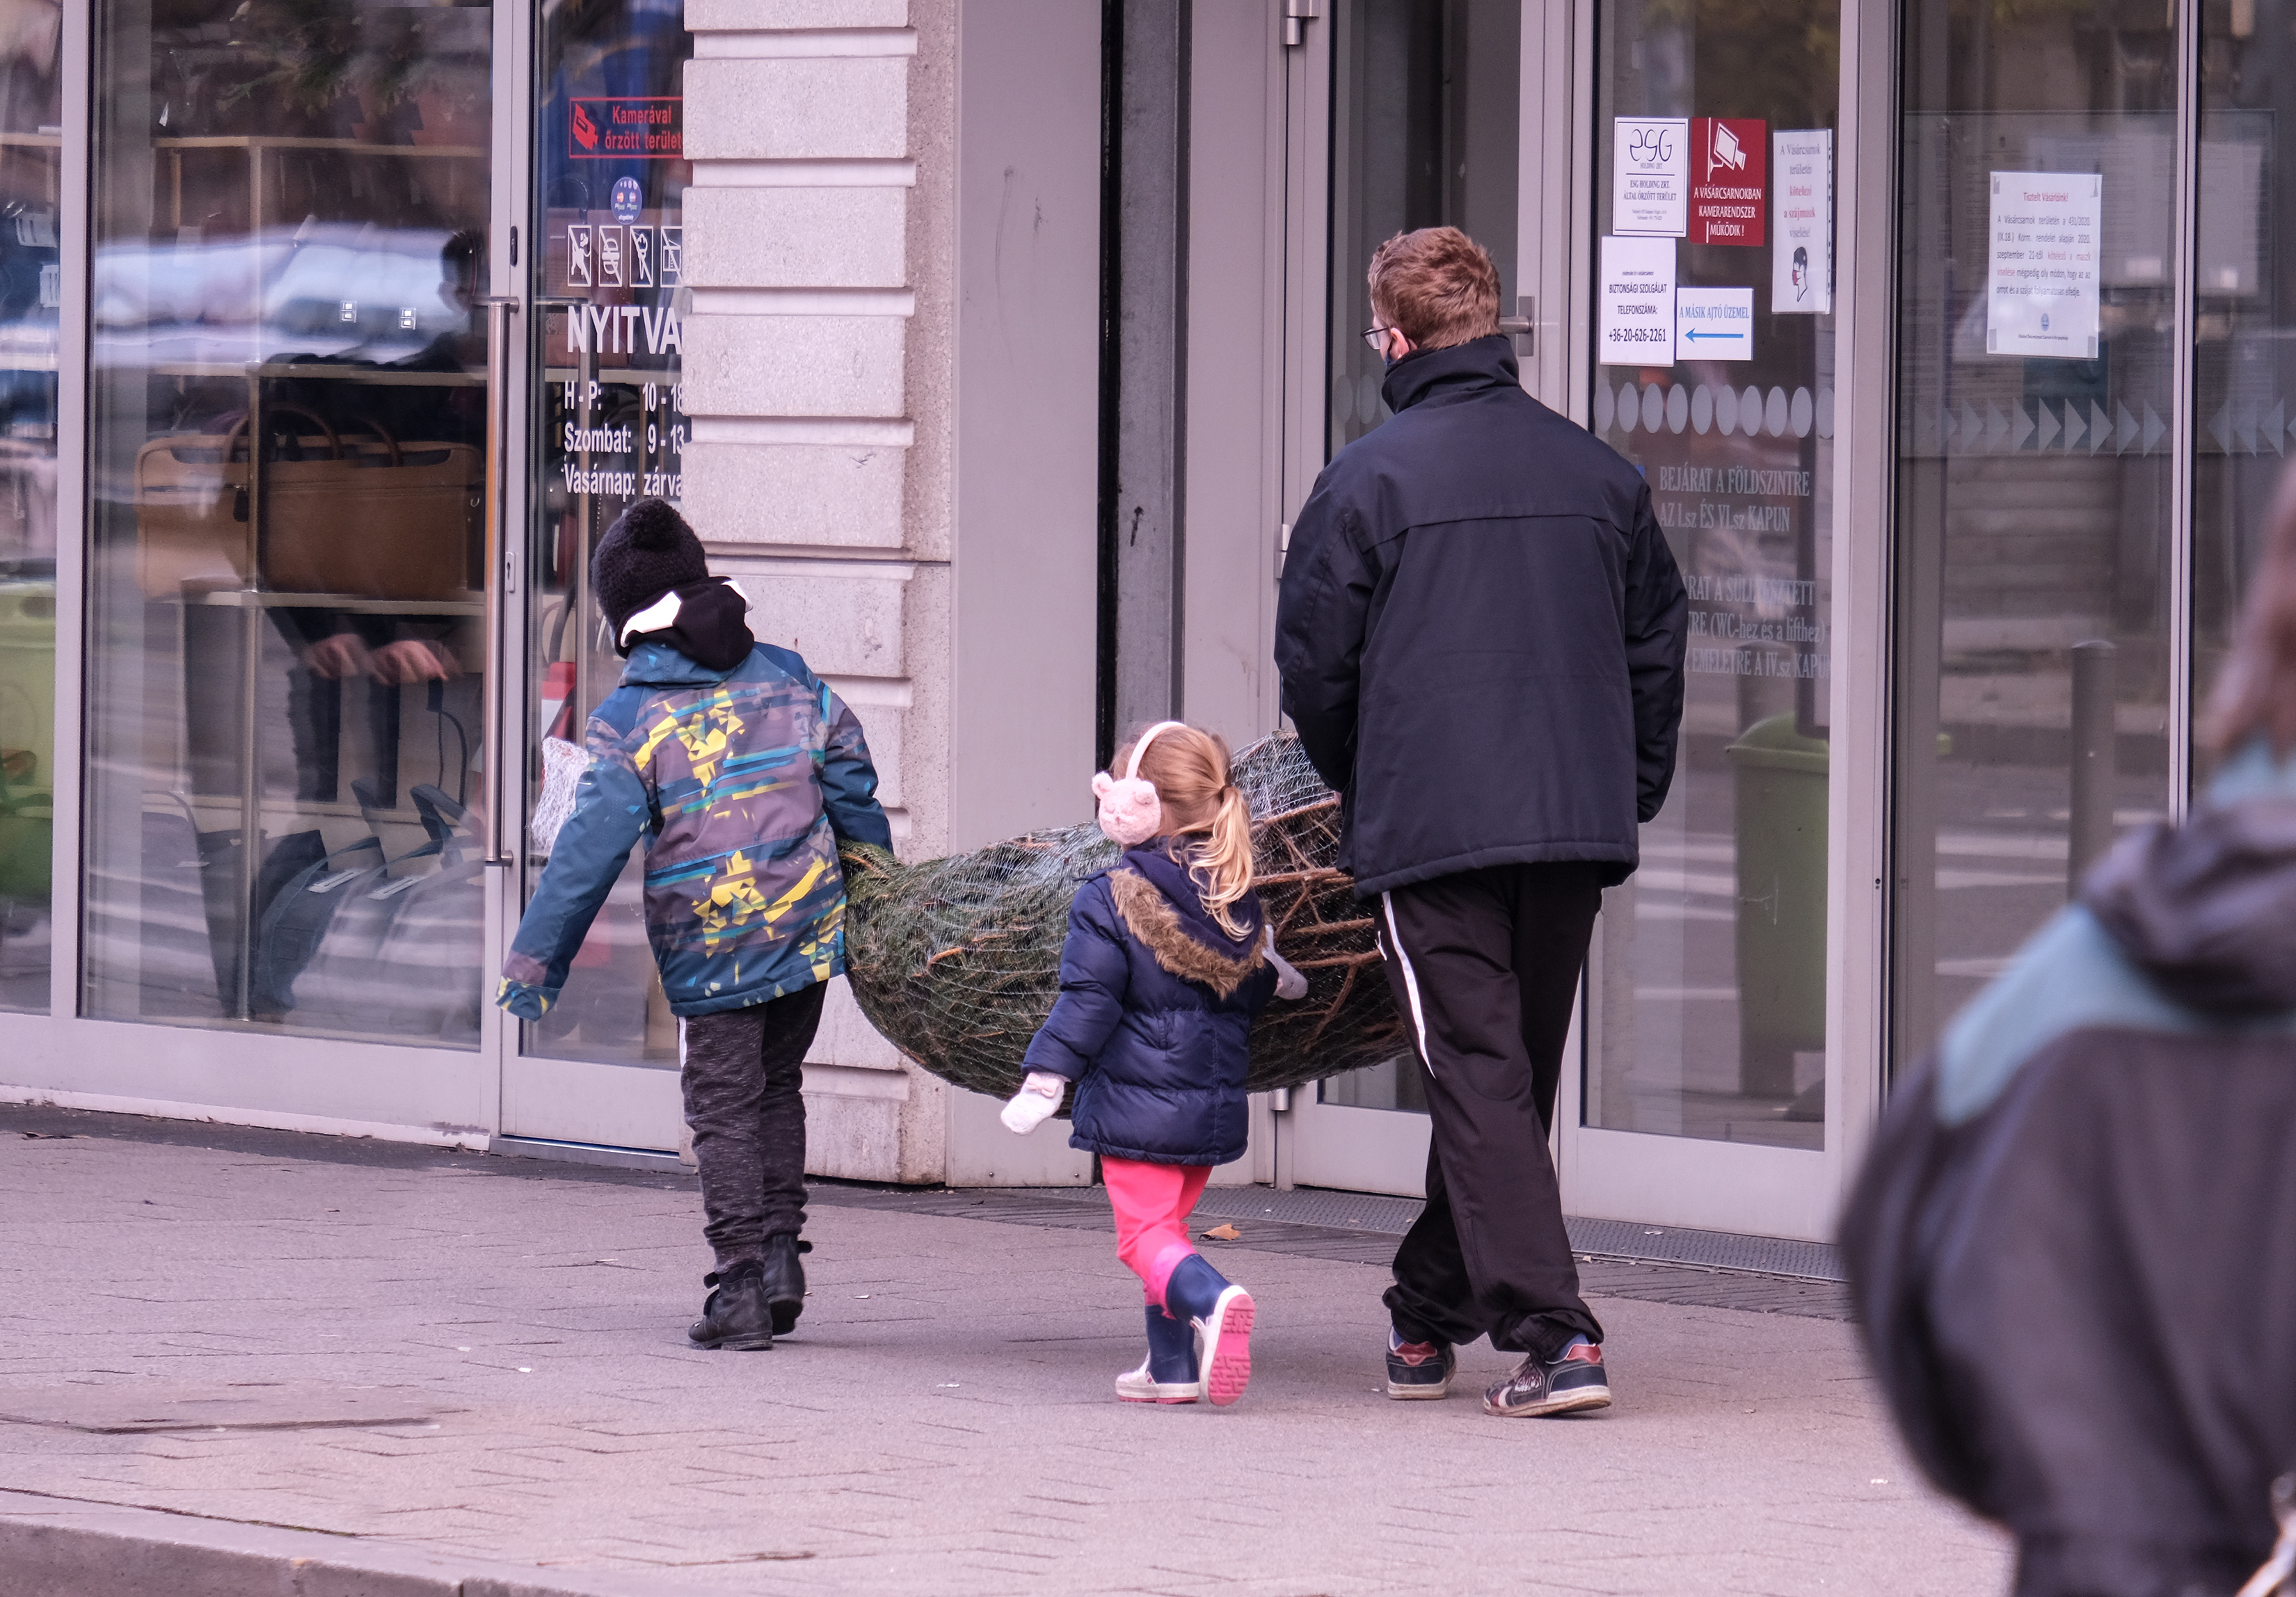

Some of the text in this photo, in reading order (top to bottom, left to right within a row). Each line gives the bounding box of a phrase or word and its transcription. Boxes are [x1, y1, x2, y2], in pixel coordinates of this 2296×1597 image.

[612, 106, 671, 124] Kamerával
[605, 130, 682, 149] őrzött terület
[1780, 145, 1785, 155] A
[1623, 190, 1637, 200] ÁLTAL
[1693, 184, 1762, 200] A VÁSÁRCSARNOKBAN
[2023, 193, 2041, 201] Tisztelt
[1698, 206, 1755, 218] KAMERARENDSZER
[1784, 210, 1787, 218] a
[2018, 234, 2032, 242] Korm.
[2078, 235, 2091, 243] 2020.
[1997, 250, 2024, 260] szeptember
[2076, 252, 2091, 261] maszk
[2067, 270, 2077, 280] hogy
[1609, 282, 1667, 294] BIZTONSÁGI SZOLGÁLAT
[1618, 303, 1657, 314] TELEFONSZÁMA:
[1680, 303, 1749, 321] A MÁSIK AJTÓ ÜZEMEL
[568, 306, 682, 355] NYITVA
[1609, 328, 1666, 342] +36-20-626-2261
[643, 383, 657, 412] 10
[671, 383, 683, 412] 18
[564, 422, 631, 453] Szombat:
[648, 424, 655, 454] 9
[671, 424, 685, 455] 13
[564, 463, 682, 502] Vasárnap: zárva
[1660, 462, 1810, 496] BEJÁRAT A FÖLDSZINTRE
[1660, 502, 1675, 527] AZ
[1700, 499, 1714, 529] ÉS
[1748, 506, 1790, 532] KAPUN
[1714, 577, 1723, 601] A
[1711, 612, 1757, 641] (WC-hez
[1761, 618, 1773, 640] és
[1777, 627, 1783, 641] a
[1786, 617, 1826, 645] lifthez)
[1692, 648, 1751, 676] EMELETRE
[1754, 652, 1762, 675] A
